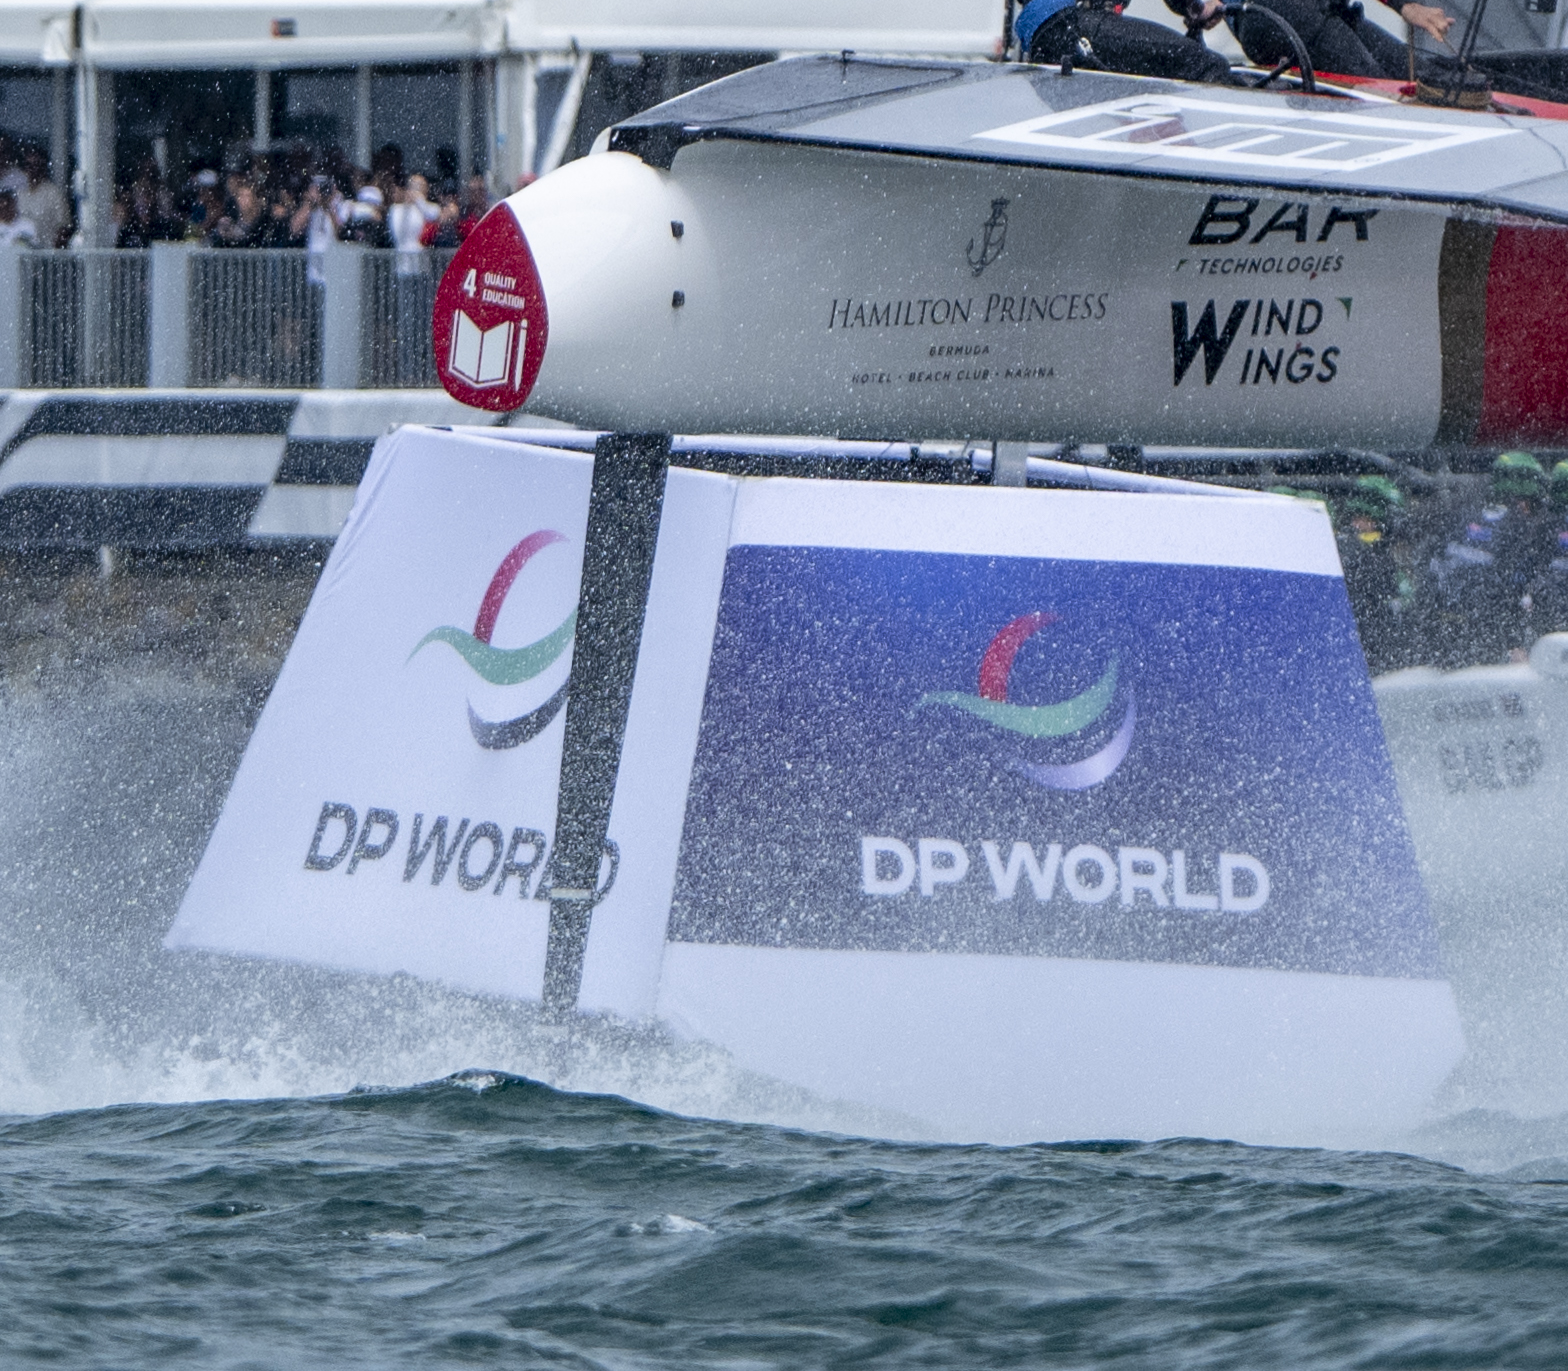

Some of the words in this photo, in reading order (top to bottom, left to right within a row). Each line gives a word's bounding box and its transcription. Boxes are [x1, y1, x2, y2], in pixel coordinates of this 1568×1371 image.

[1199, 255, 1345, 275] TECHNOLOGIES
[463, 268, 478, 298] 4
[484, 272, 518, 291] QUALITY
[482, 288, 526, 310] EDUCATION
[929, 344, 991, 357] BERMUDA
[852, 372, 894, 385] HOTEL
[908, 370, 951, 383] BEACH
[956, 368, 990, 381] CLUB
[1004, 366, 1055, 380] MARINA
[303, 801, 400, 875] DP
[861, 835, 971, 898] DP
[981, 840, 1271, 913] WORLD
